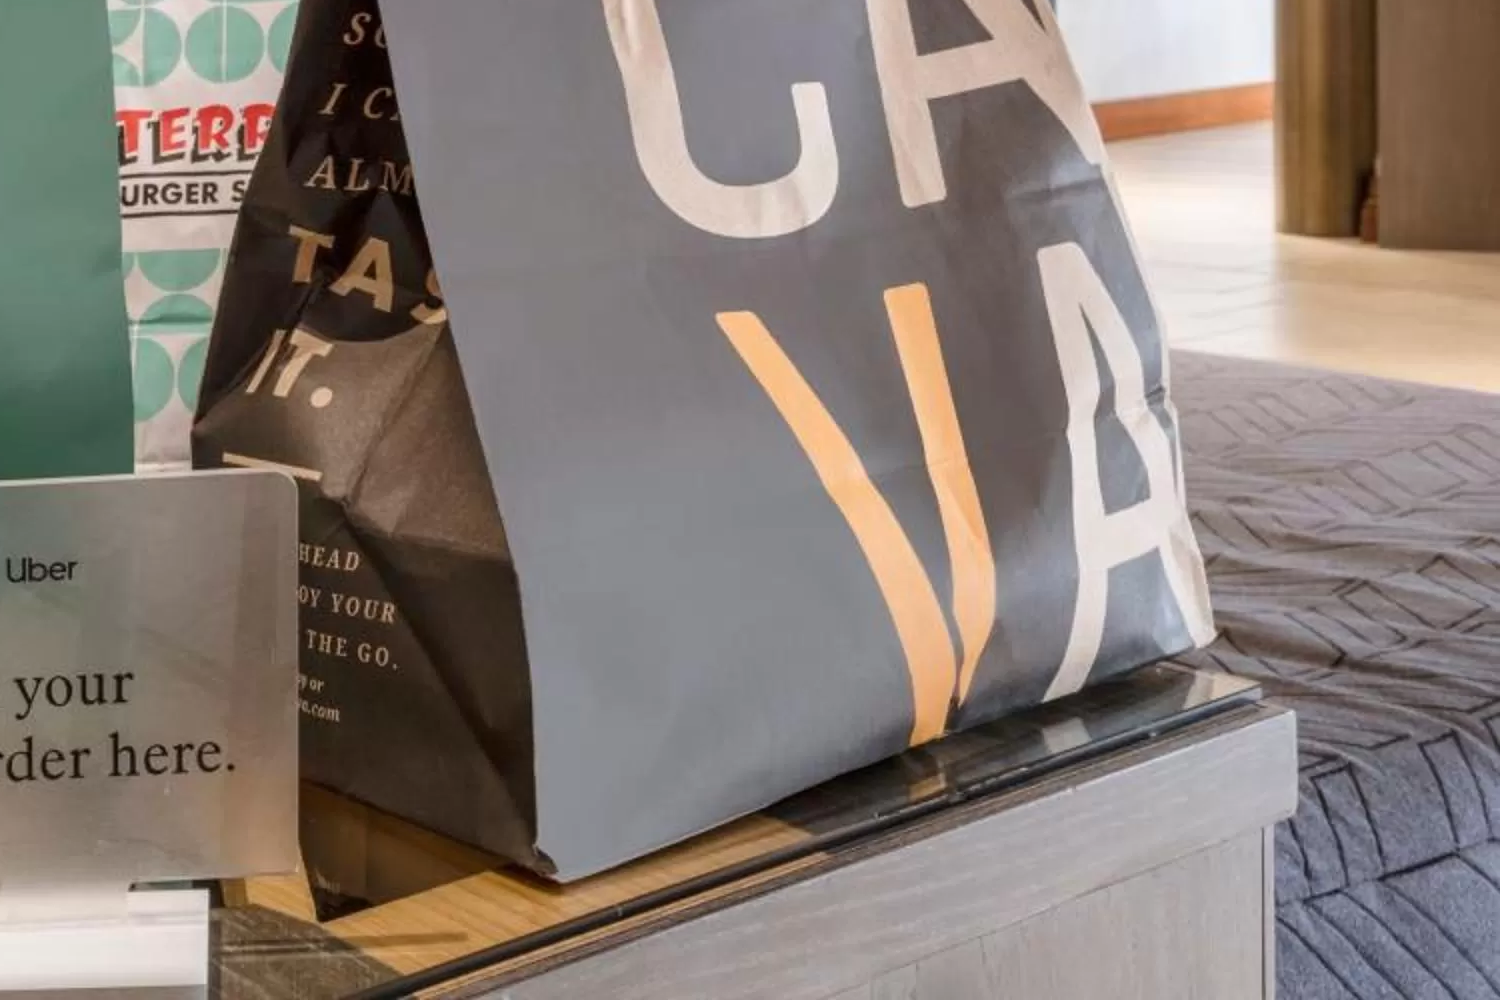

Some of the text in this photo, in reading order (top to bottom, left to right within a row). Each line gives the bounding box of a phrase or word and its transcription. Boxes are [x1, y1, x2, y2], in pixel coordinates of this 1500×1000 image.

[317, 83, 400, 121] I C
[121, 181, 219, 207] URGER
[245, 328, 333, 409] IT.
[6, 556, 79, 583] Uber
[331, 592, 397, 625] YOUR
[306, 629, 399, 671] THE GO.
[13, 670, 134, 720] your
[107, 731, 236, 778] here.
